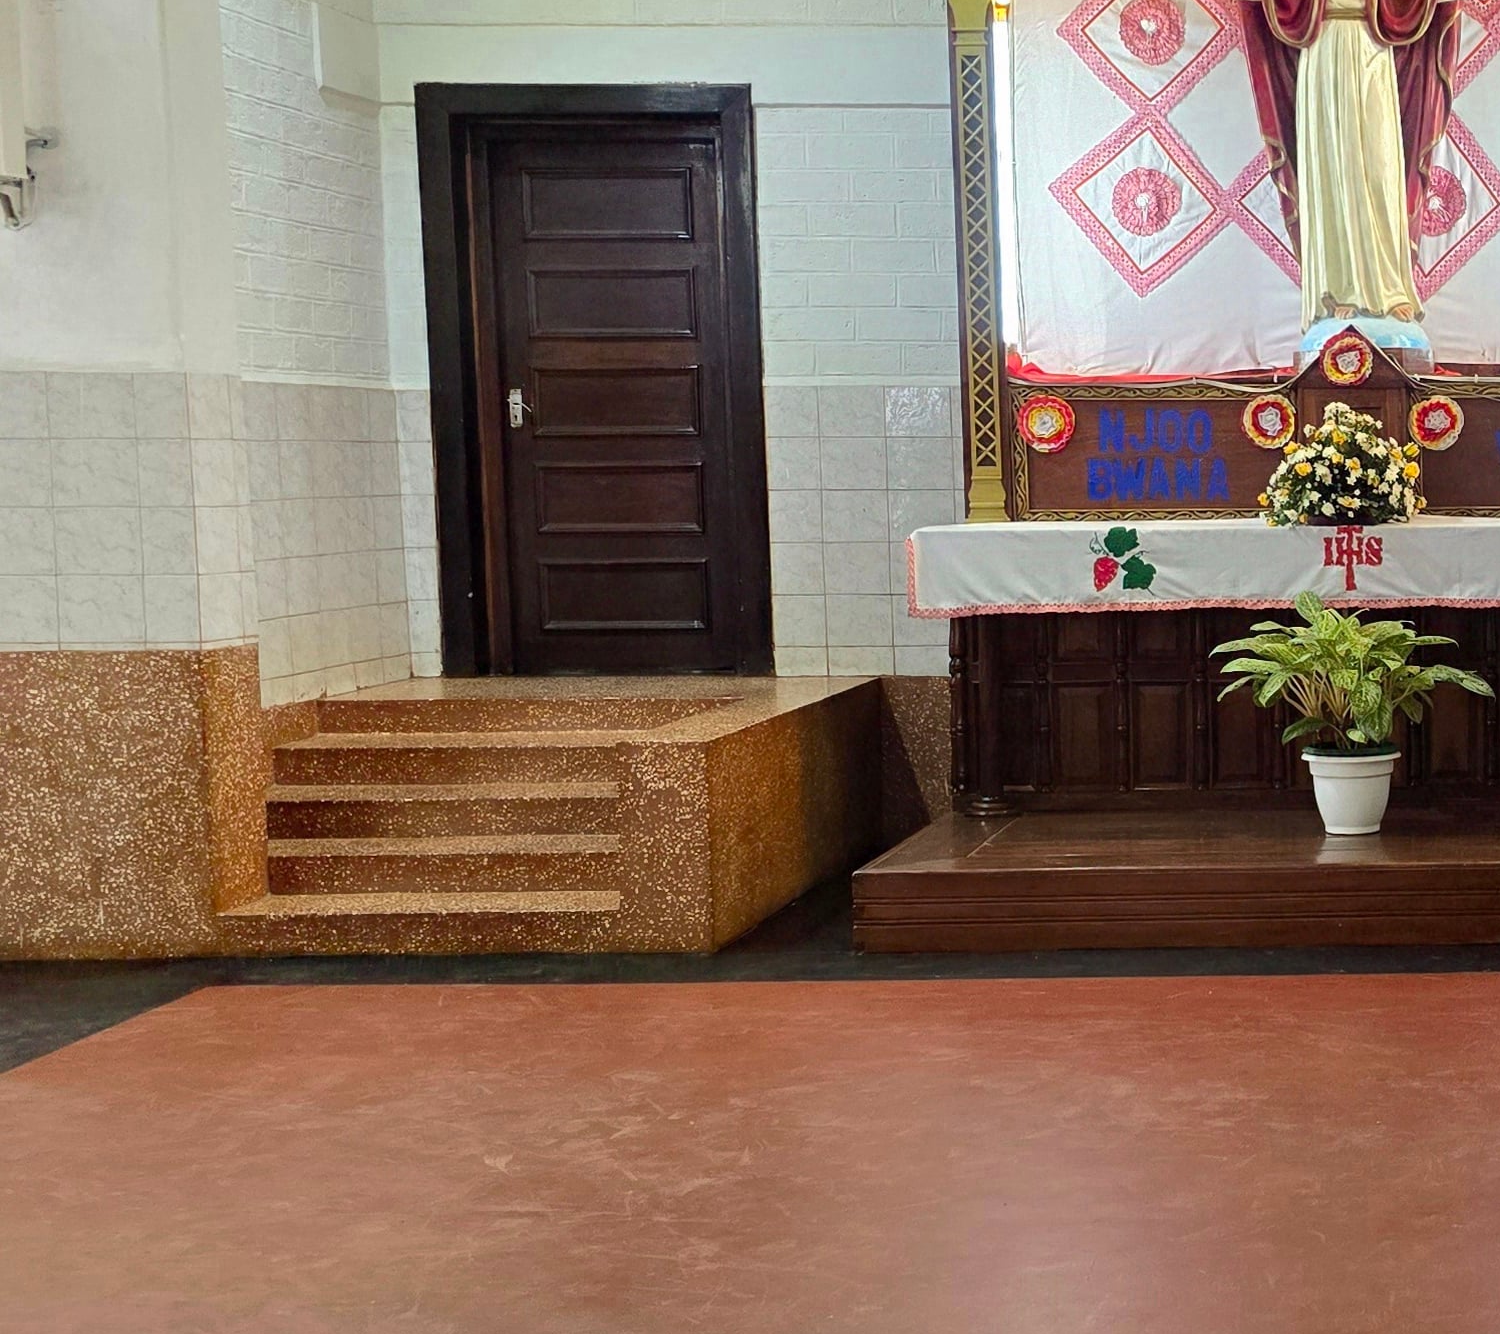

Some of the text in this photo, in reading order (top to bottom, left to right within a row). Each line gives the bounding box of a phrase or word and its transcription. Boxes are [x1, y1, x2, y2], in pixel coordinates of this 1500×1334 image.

[1098, 407, 1212, 454] NJOO
[1086, 456, 1231, 502] BWANA
[1322, 527, 1384, 569] IHS
